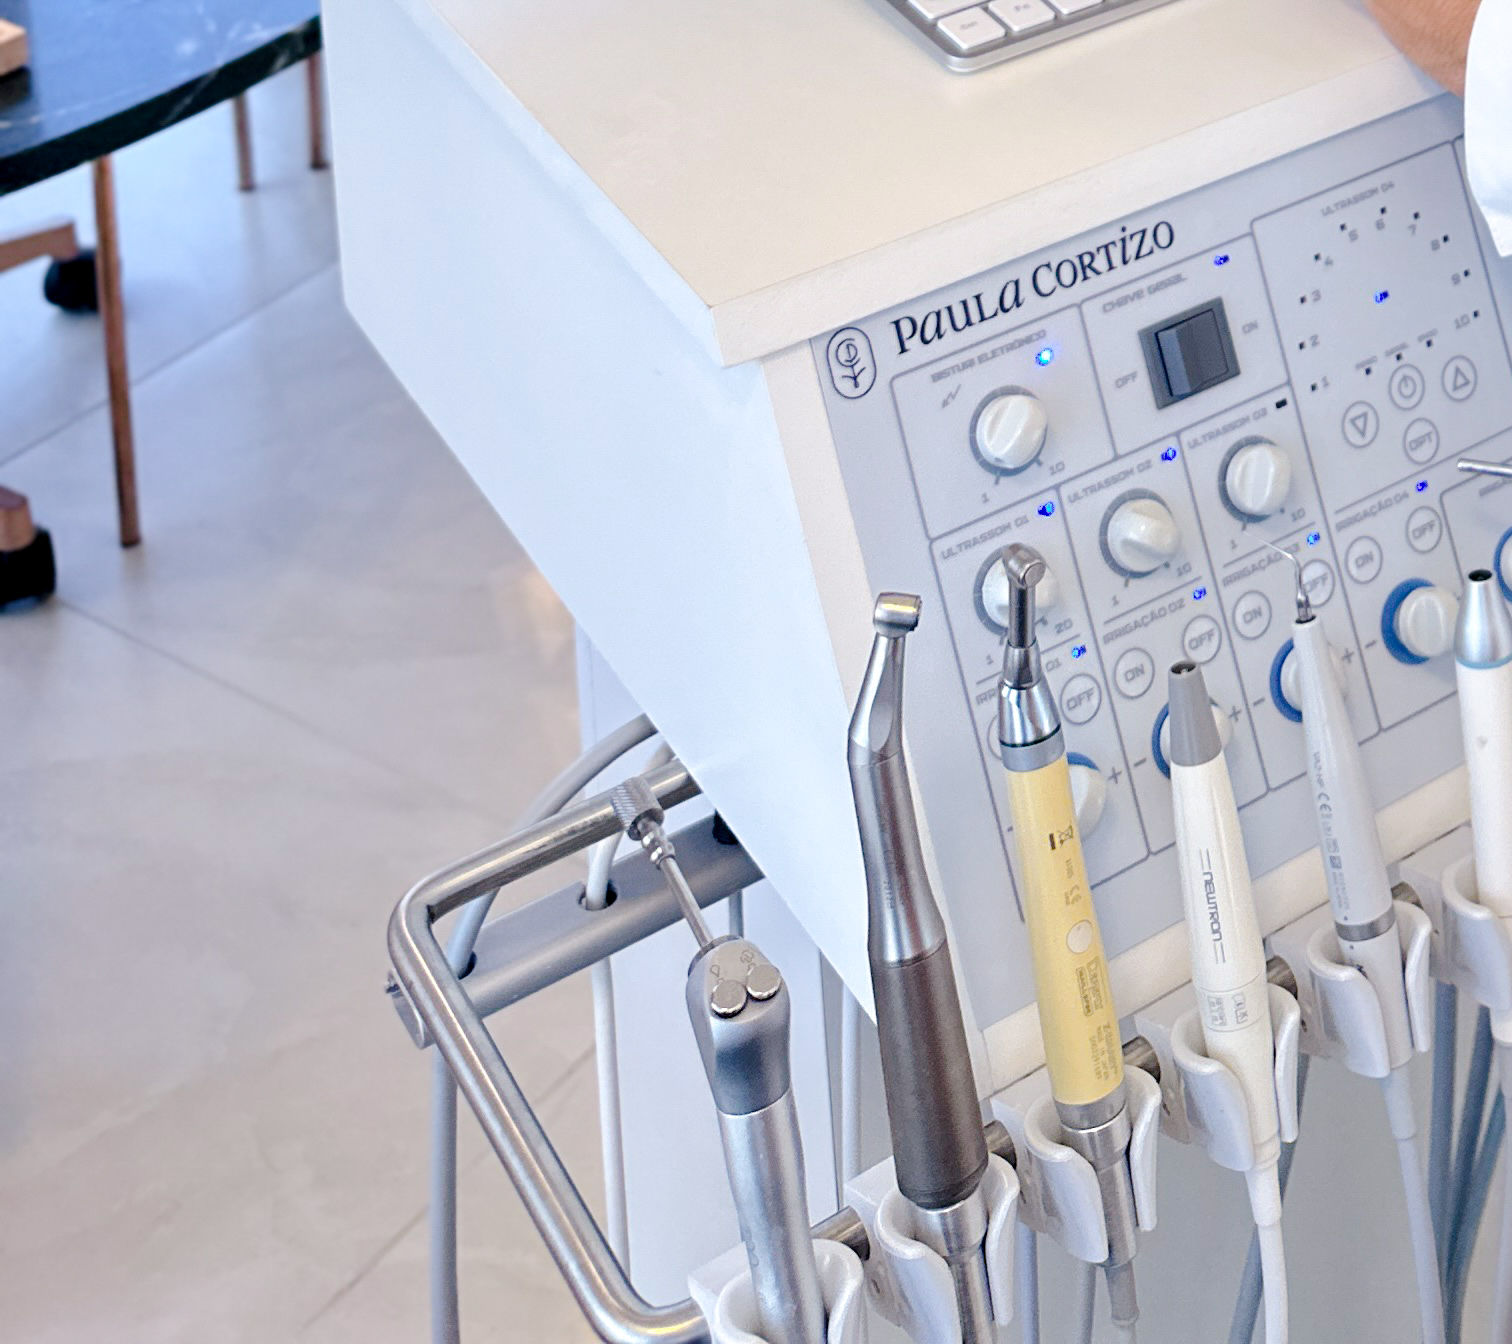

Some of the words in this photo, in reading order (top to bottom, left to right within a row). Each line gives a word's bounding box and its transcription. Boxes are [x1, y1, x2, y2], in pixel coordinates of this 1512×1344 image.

[1114, 371, 1138, 389] OFF
[1187, 415, 1250, 450] ULTRASSOM
[1252, 407, 1268, 421] 03
[1049, 461, 1066, 474] 10
[1067, 468, 1135, 504] ULTRASSOM
[1136, 458, 1154, 474] 02
[1291, 507, 1307, 522] 10
[941, 521, 1012, 561] ULTRASSOM
[1013, 514, 1030, 530] 01
[1410, 519, 1436, 540] OFF
[1176, 562, 1193, 577] 10
[1353, 551, 1375, 569] ON
[1054, 618, 1074, 634] 20
[1103, 604, 1168, 644] IRRIGAÇÃO
[1168, 597, 1186, 613] 02
[1242, 606, 1263, 625] ON
[1187, 626, 1216, 651] OFF
[1123, 662, 1146, 683] ON
[1065, 687, 1096, 712] OFF
